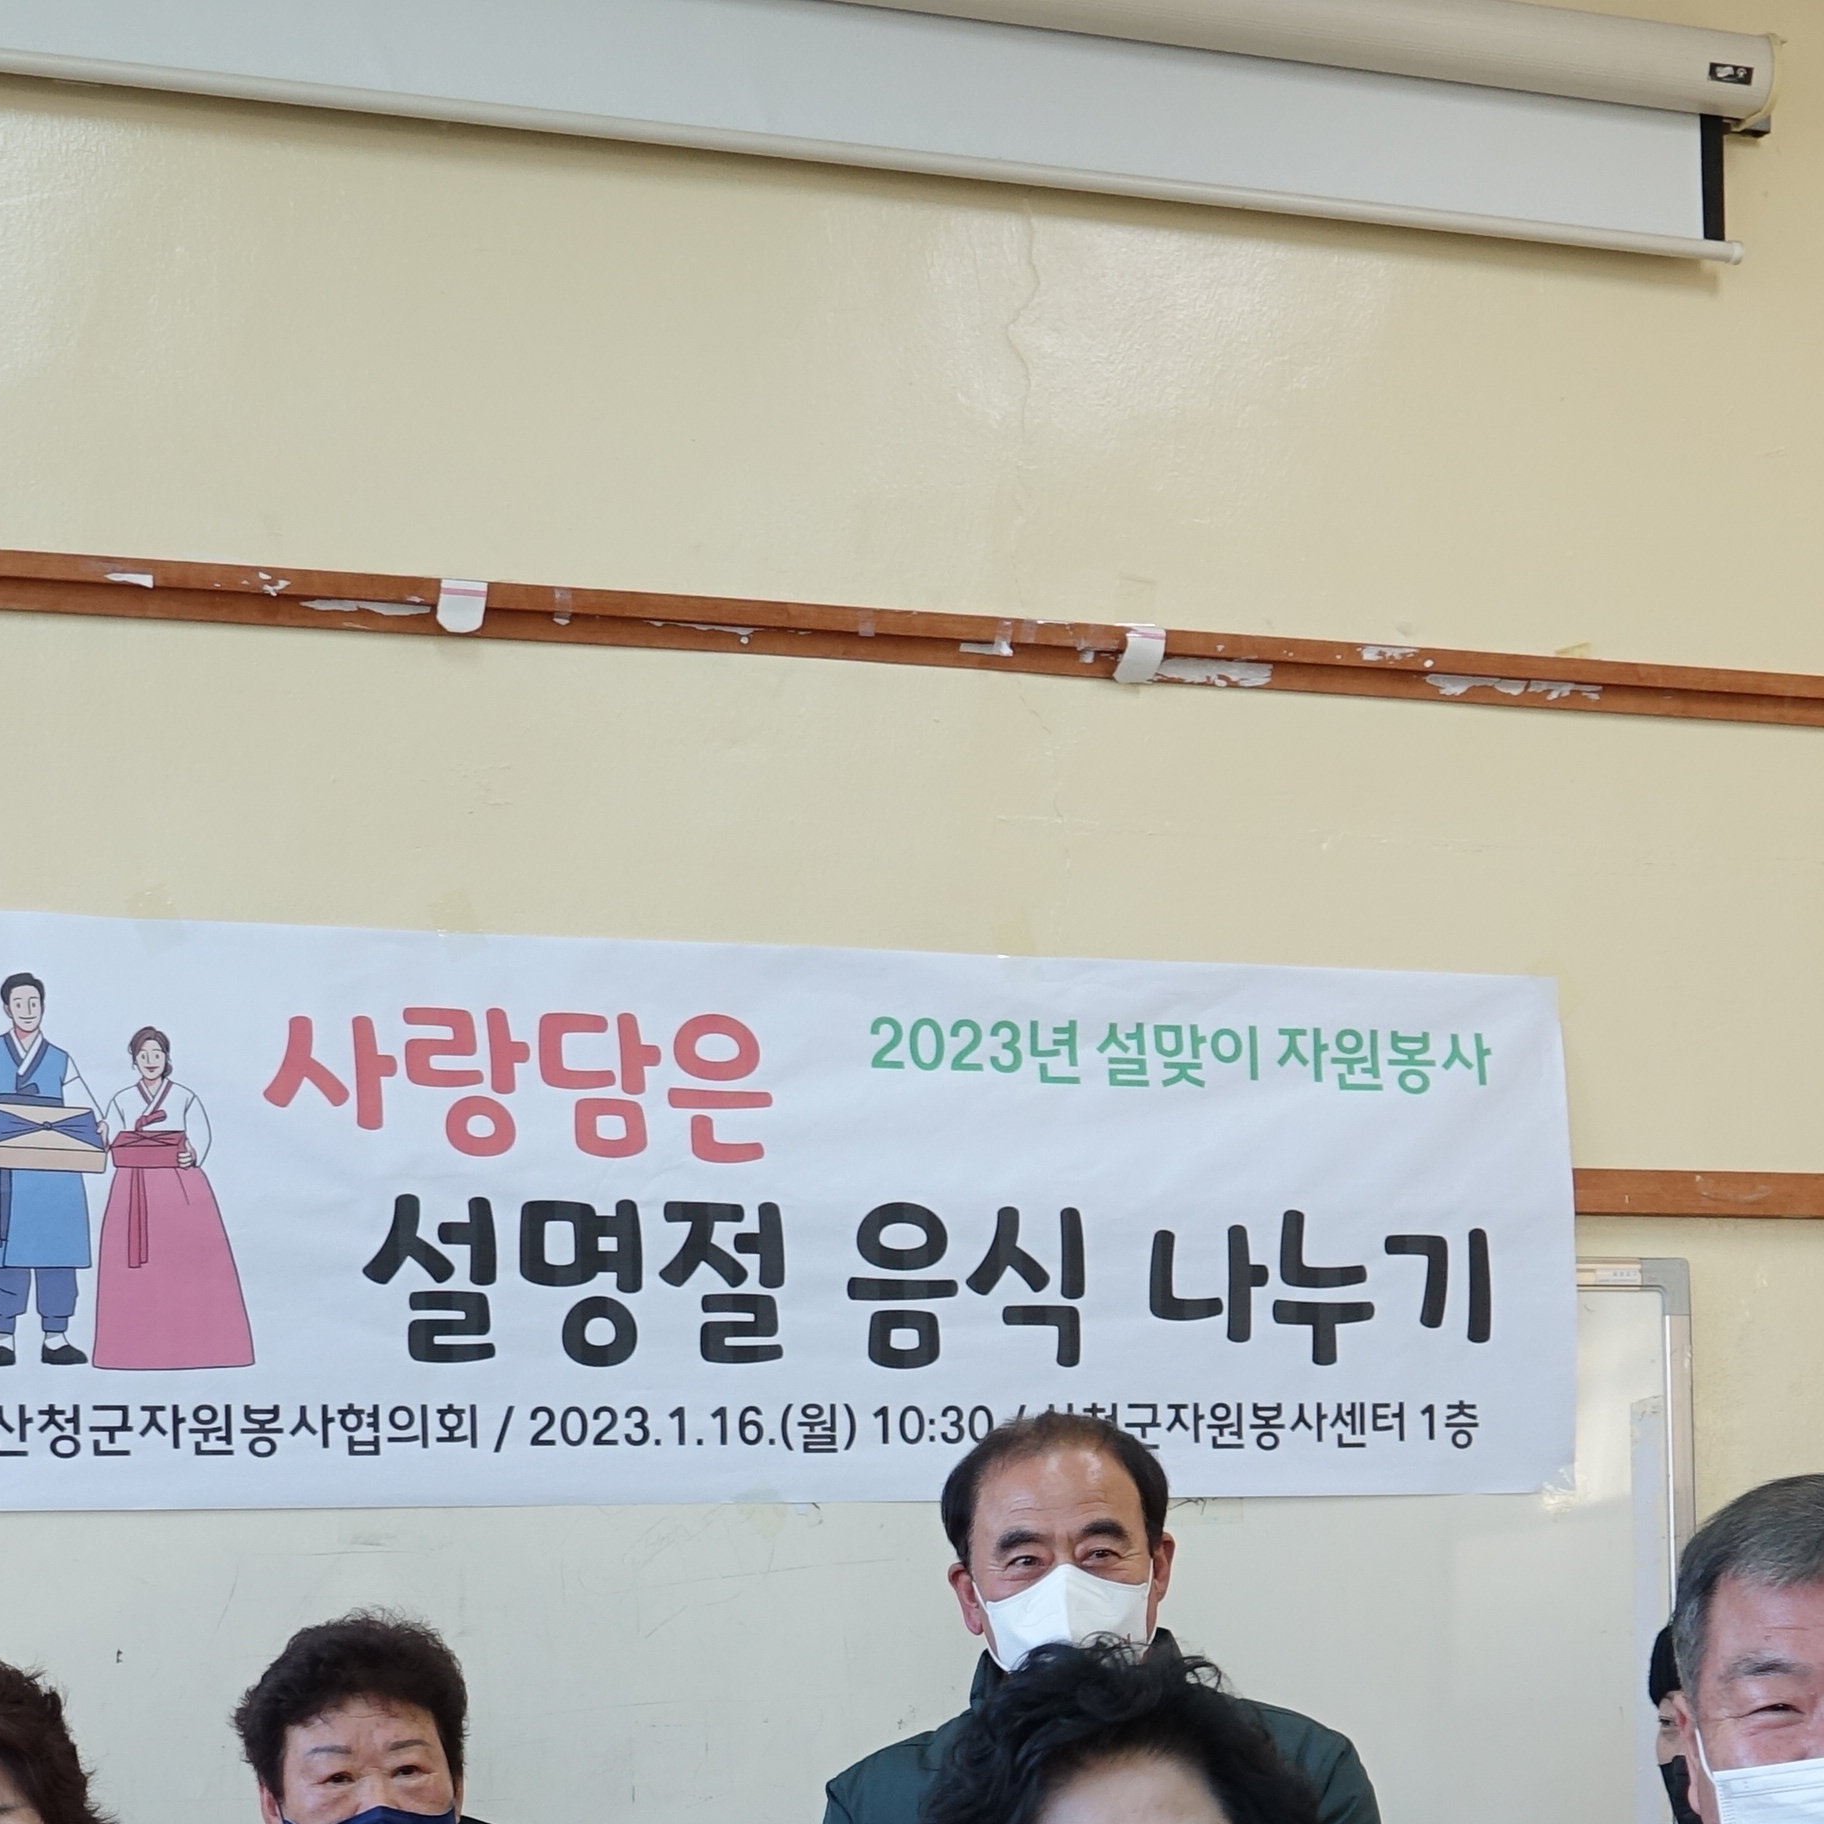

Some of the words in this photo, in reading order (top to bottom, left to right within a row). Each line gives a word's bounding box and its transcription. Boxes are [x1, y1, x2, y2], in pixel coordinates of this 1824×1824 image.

[263, 1006, 774, 1163] 사랑담은
[869, 1015, 1082, 1085] 2023년
[1095, 1021, 1261, 1089] 설맞이
[1276, 1026, 1493, 1095] 자원봉사
[362, 1193, 787, 1368] 설명절
[846, 1200, 1087, 1369] 음식
[1148, 1208, 1493, 1367] 나누기
[529, 1402, 856, 1455] 2023.1.16.(월)
[871, 1402, 995, 1445] 10:30
[1418, 1401, 1481, 1449] 1층
